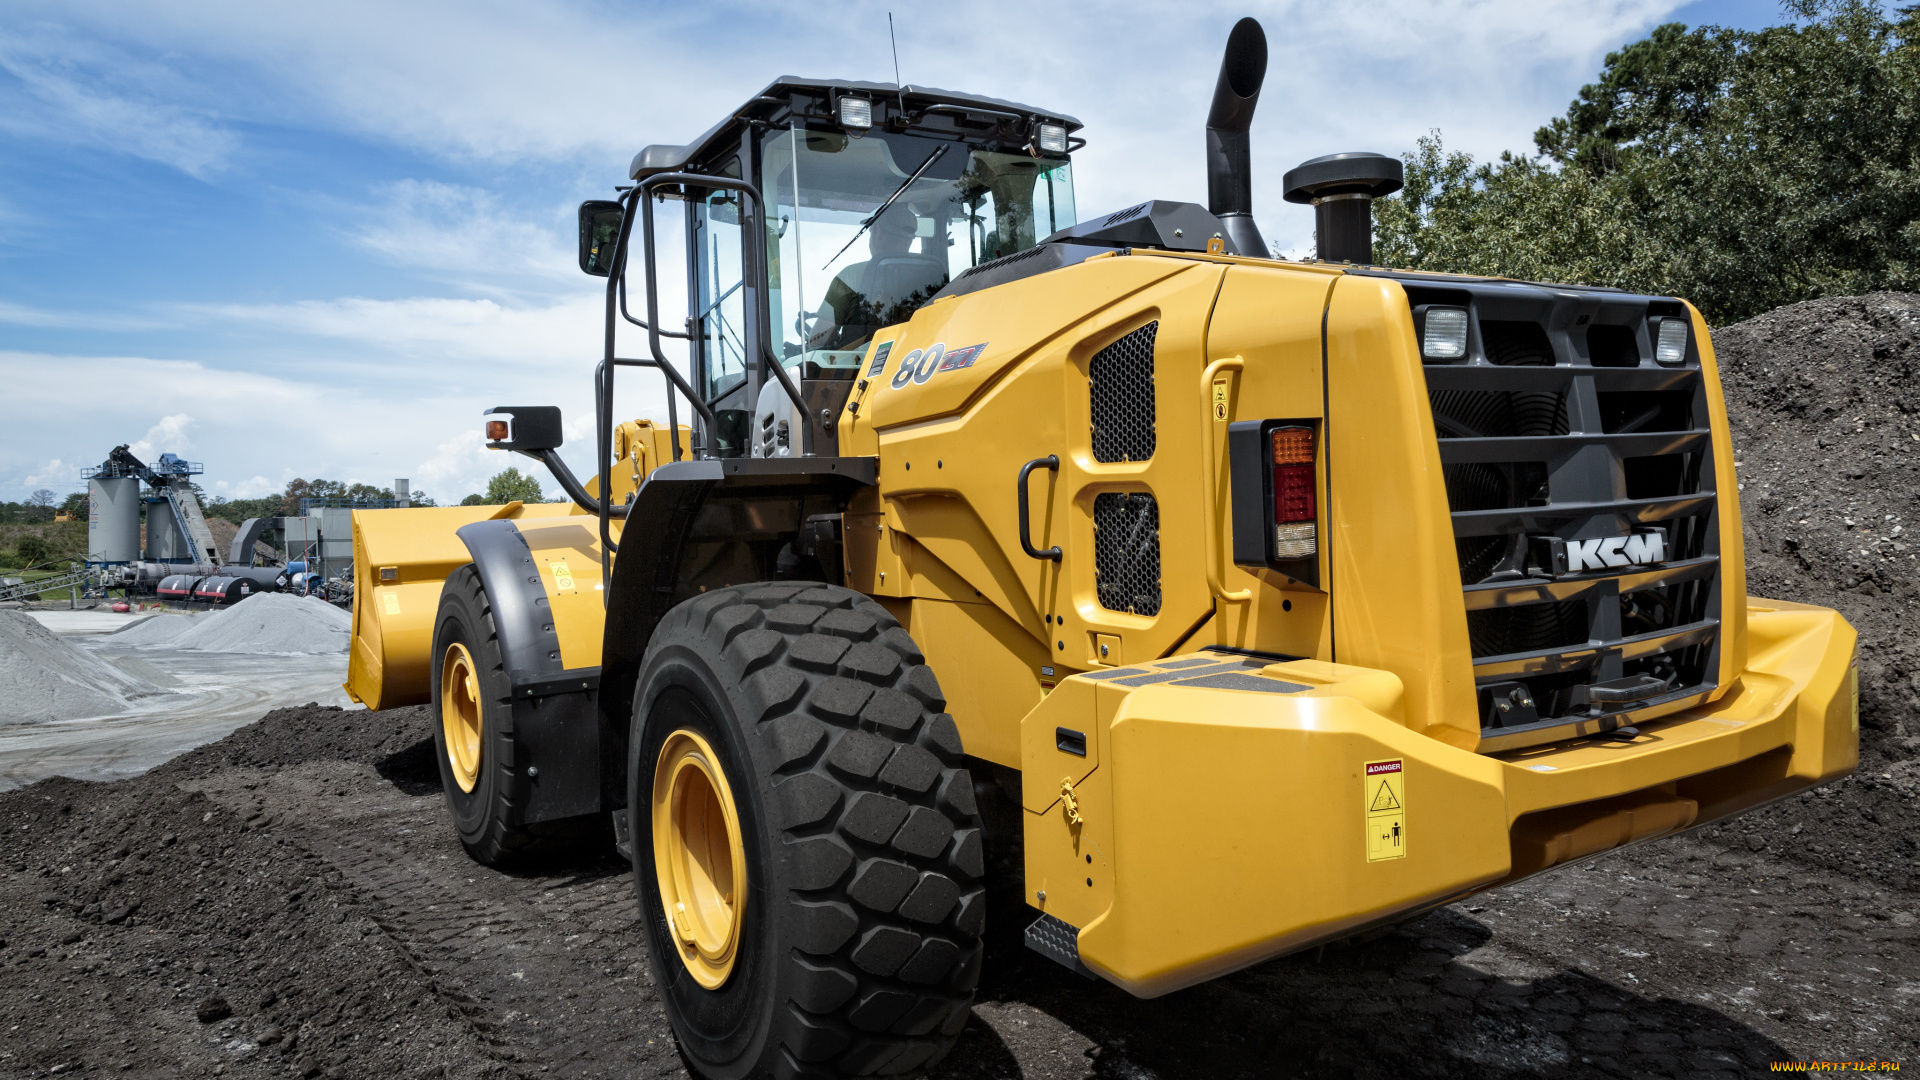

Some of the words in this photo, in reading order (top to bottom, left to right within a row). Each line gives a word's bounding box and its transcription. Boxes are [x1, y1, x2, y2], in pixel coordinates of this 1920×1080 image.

[891, 342, 946, 390] 80
[1566, 532, 1664, 572] KCM
[1373, 763, 1401, 772] DANGER
